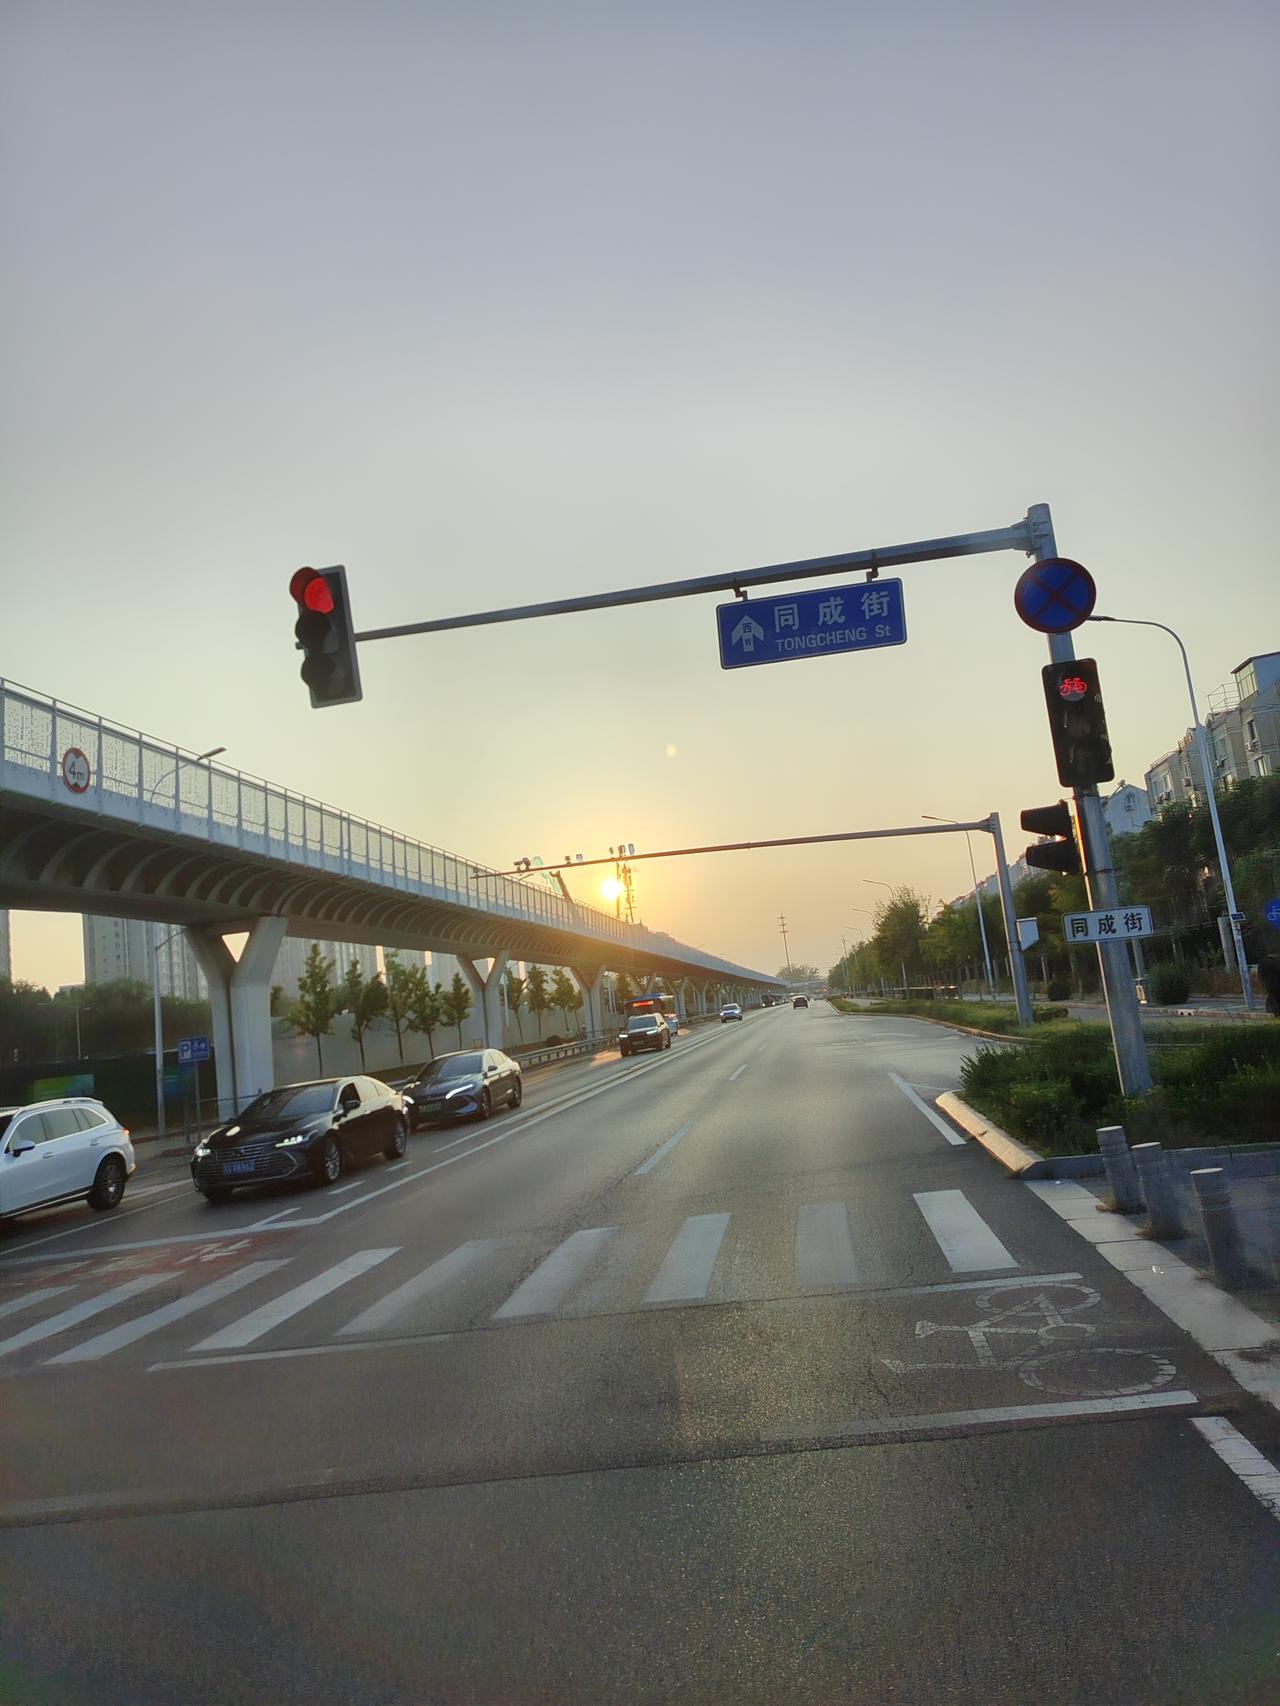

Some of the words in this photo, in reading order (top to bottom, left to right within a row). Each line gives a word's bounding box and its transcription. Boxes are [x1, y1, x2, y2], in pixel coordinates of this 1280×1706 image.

[773, 591, 891, 633] 同成街
[741, 622, 753, 634] 西
[775, 627, 868, 652] TONGCHENG
[875, 624, 892, 639] St
[1070, 912, 1143, 938] 同成街
[181, 1043, 190, 1057] P
